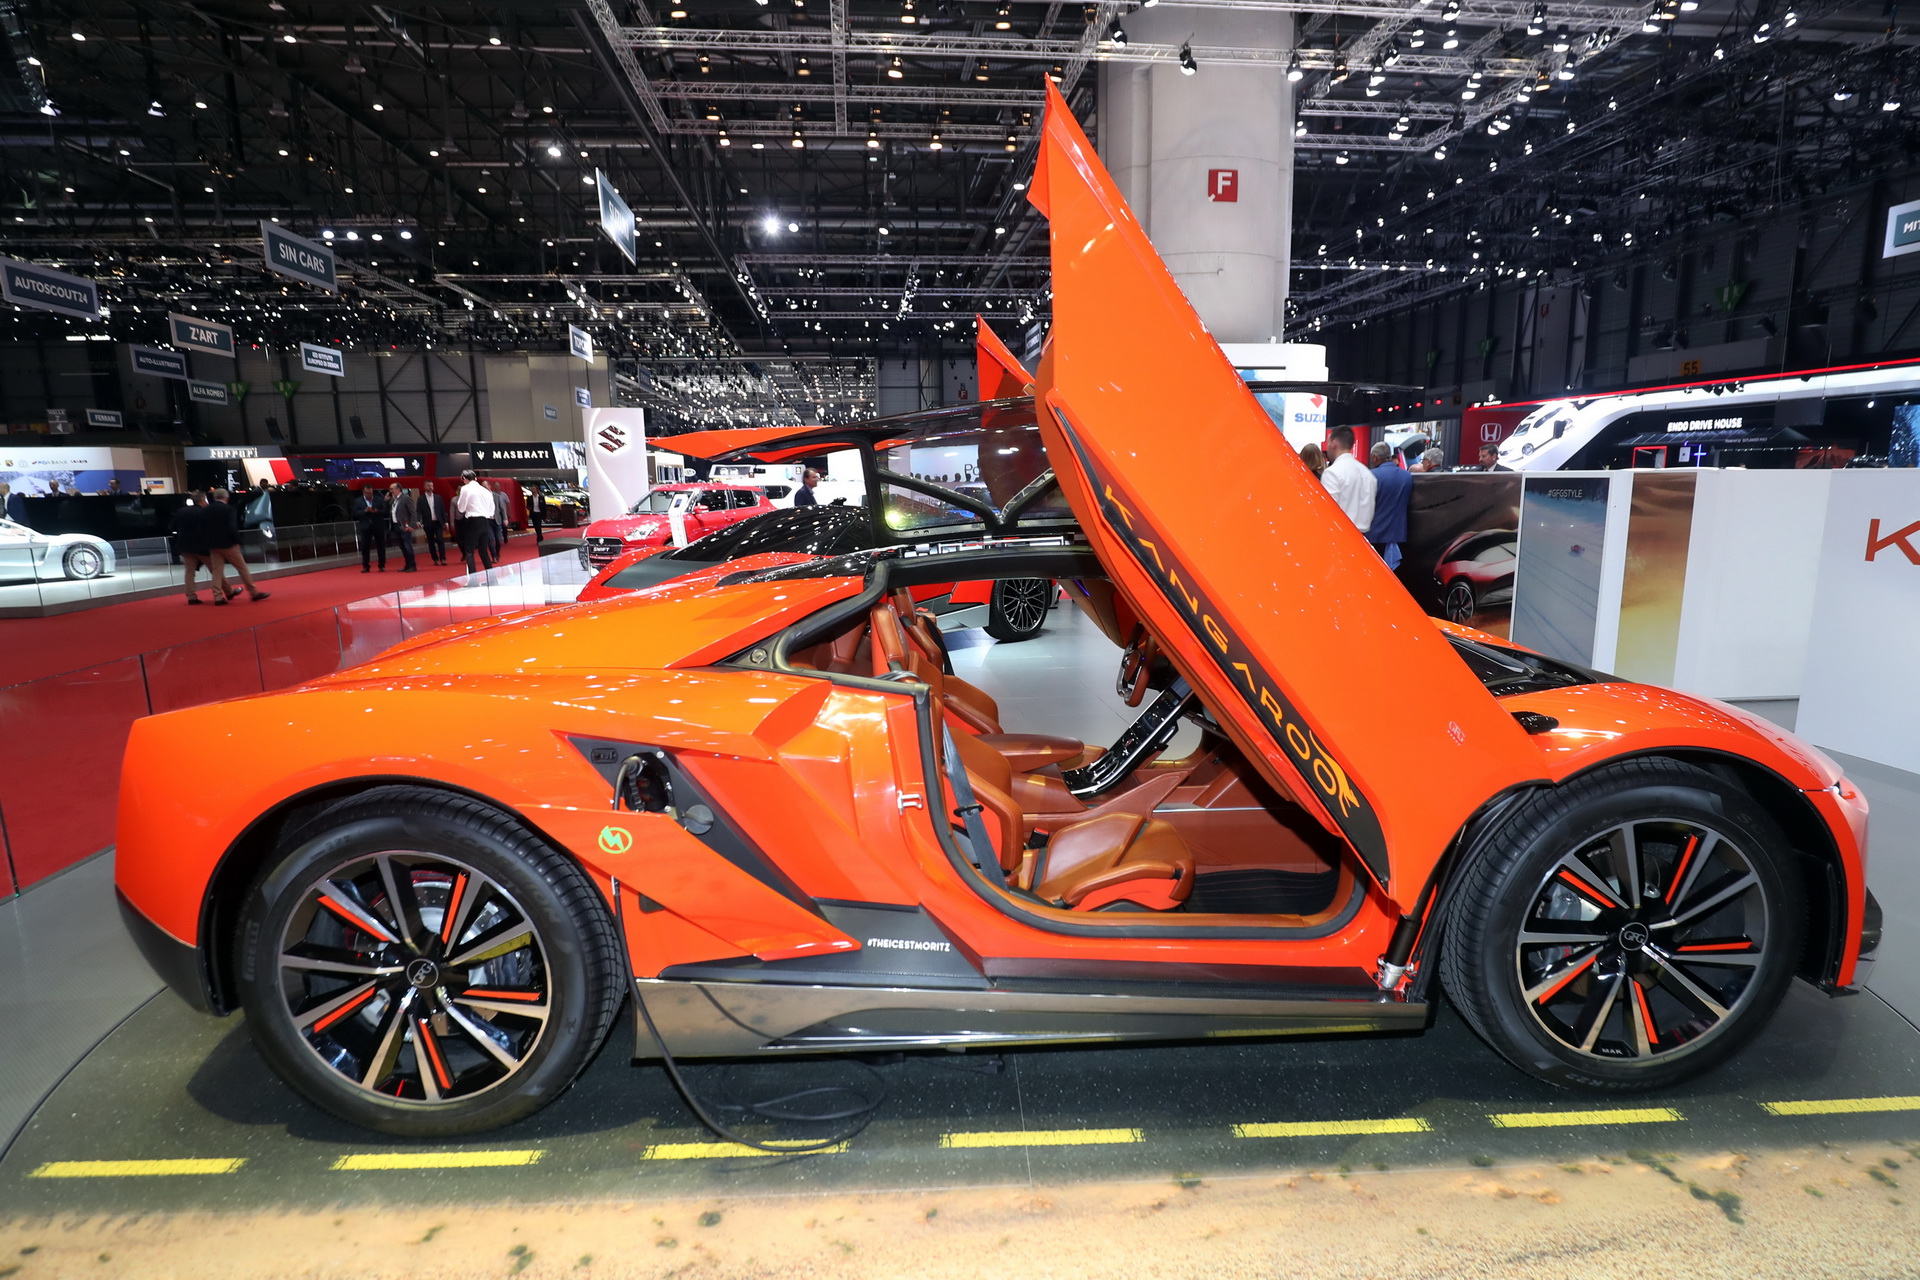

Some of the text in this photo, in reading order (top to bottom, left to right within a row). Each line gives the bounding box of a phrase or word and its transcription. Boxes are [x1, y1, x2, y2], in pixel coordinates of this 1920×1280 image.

[1217, 171, 1233, 195] F
[279, 242, 326, 274] SIN CARS
[15, 275, 88, 304] AUTOSCOUT24
[189, 326, 218, 345] Z'ART
[1683, 360, 1698, 376] 55
[206, 390, 225, 398] ROMEO
[94, 414, 117, 423] FERRARI
[1689, 419, 1713, 431] DRIVE
[1714, 417, 1743, 430] HOUSE
[492, 450, 549, 459] MASERATI
[1547, 489, 1583, 498] #GFGSTYLE
[1104, 484, 1338, 796] KANGAROO
[867, 938, 951, 953] #THEICESTMORITZ
[1601, 1047, 1624, 1055] MAK
